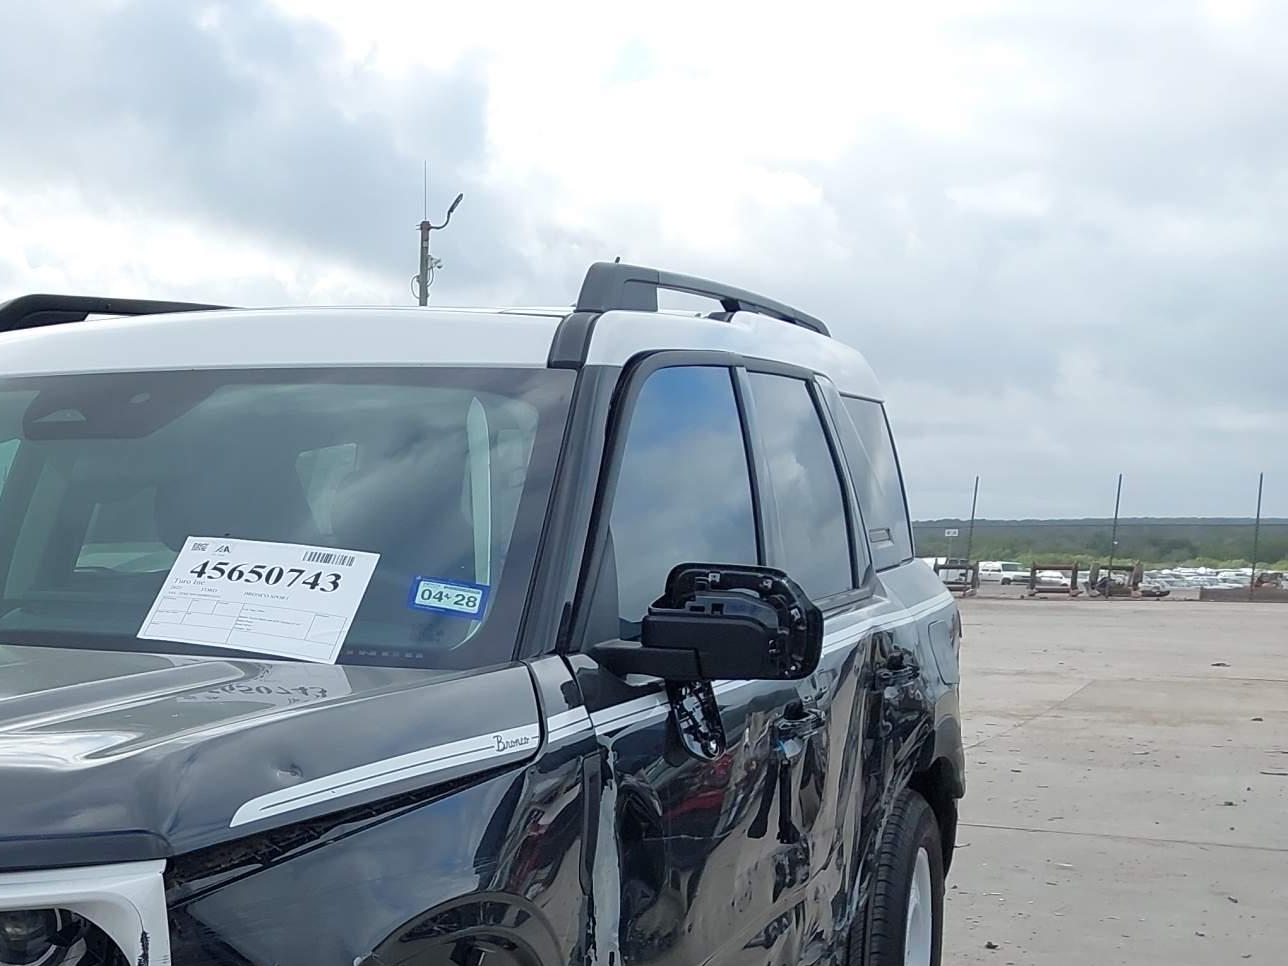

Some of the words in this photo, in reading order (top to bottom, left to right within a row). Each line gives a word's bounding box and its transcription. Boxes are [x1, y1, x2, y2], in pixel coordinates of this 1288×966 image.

[190, 560, 341, 593] 45650743
[421, 588, 443, 602] 04
[453, 593, 478, 608] 28
[492, 735, 530, 752] Bronco
